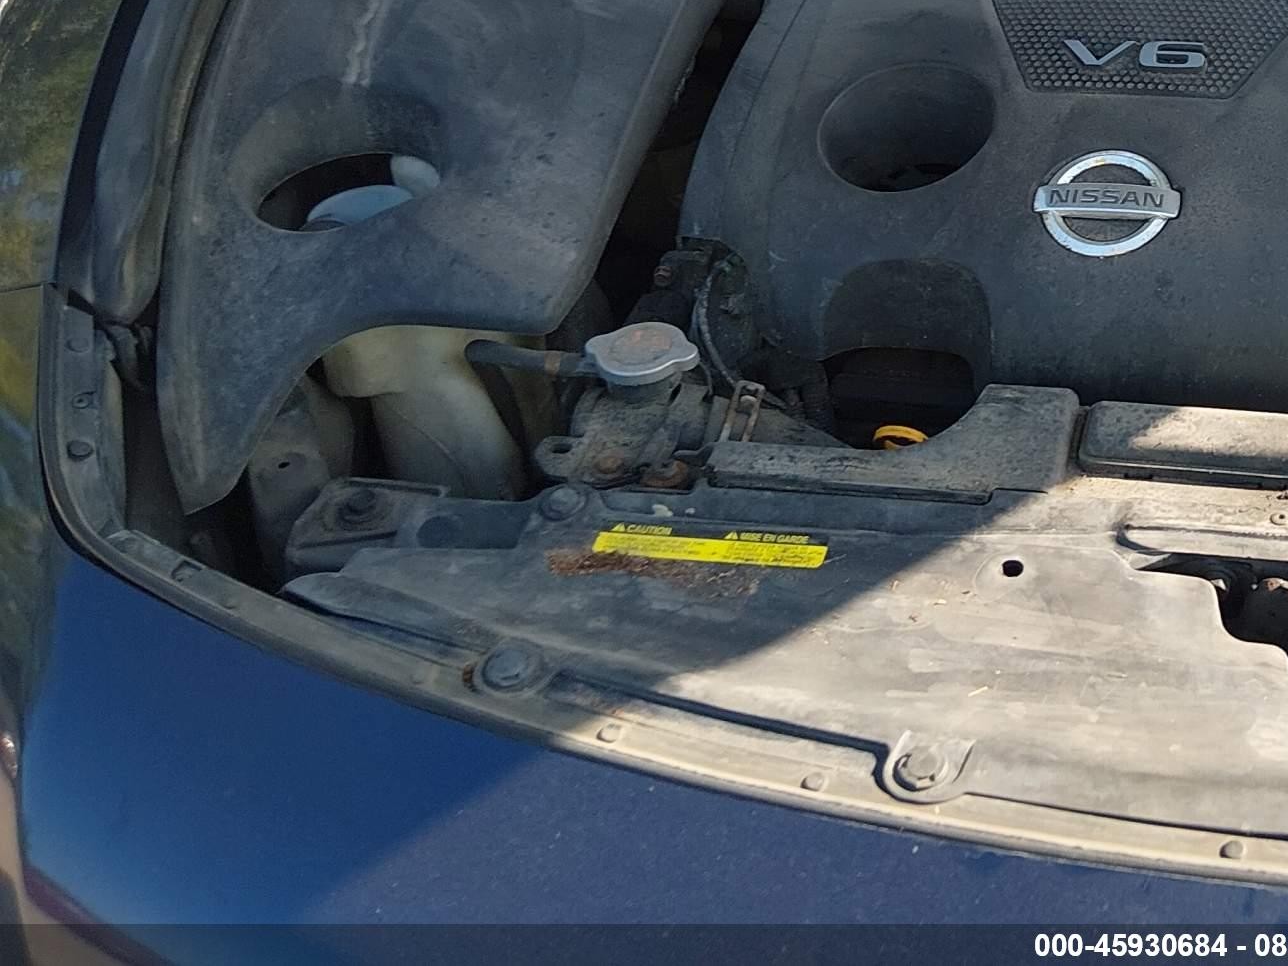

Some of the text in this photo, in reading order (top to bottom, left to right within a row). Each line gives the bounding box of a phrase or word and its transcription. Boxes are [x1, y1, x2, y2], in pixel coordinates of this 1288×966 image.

[1063, 39, 1207, 69] V6
[1049, 189, 1165, 208] NISSAN
[626, 524, 673, 536] CAUTION
[739, 532, 810, 545] MISE EN GARDE
